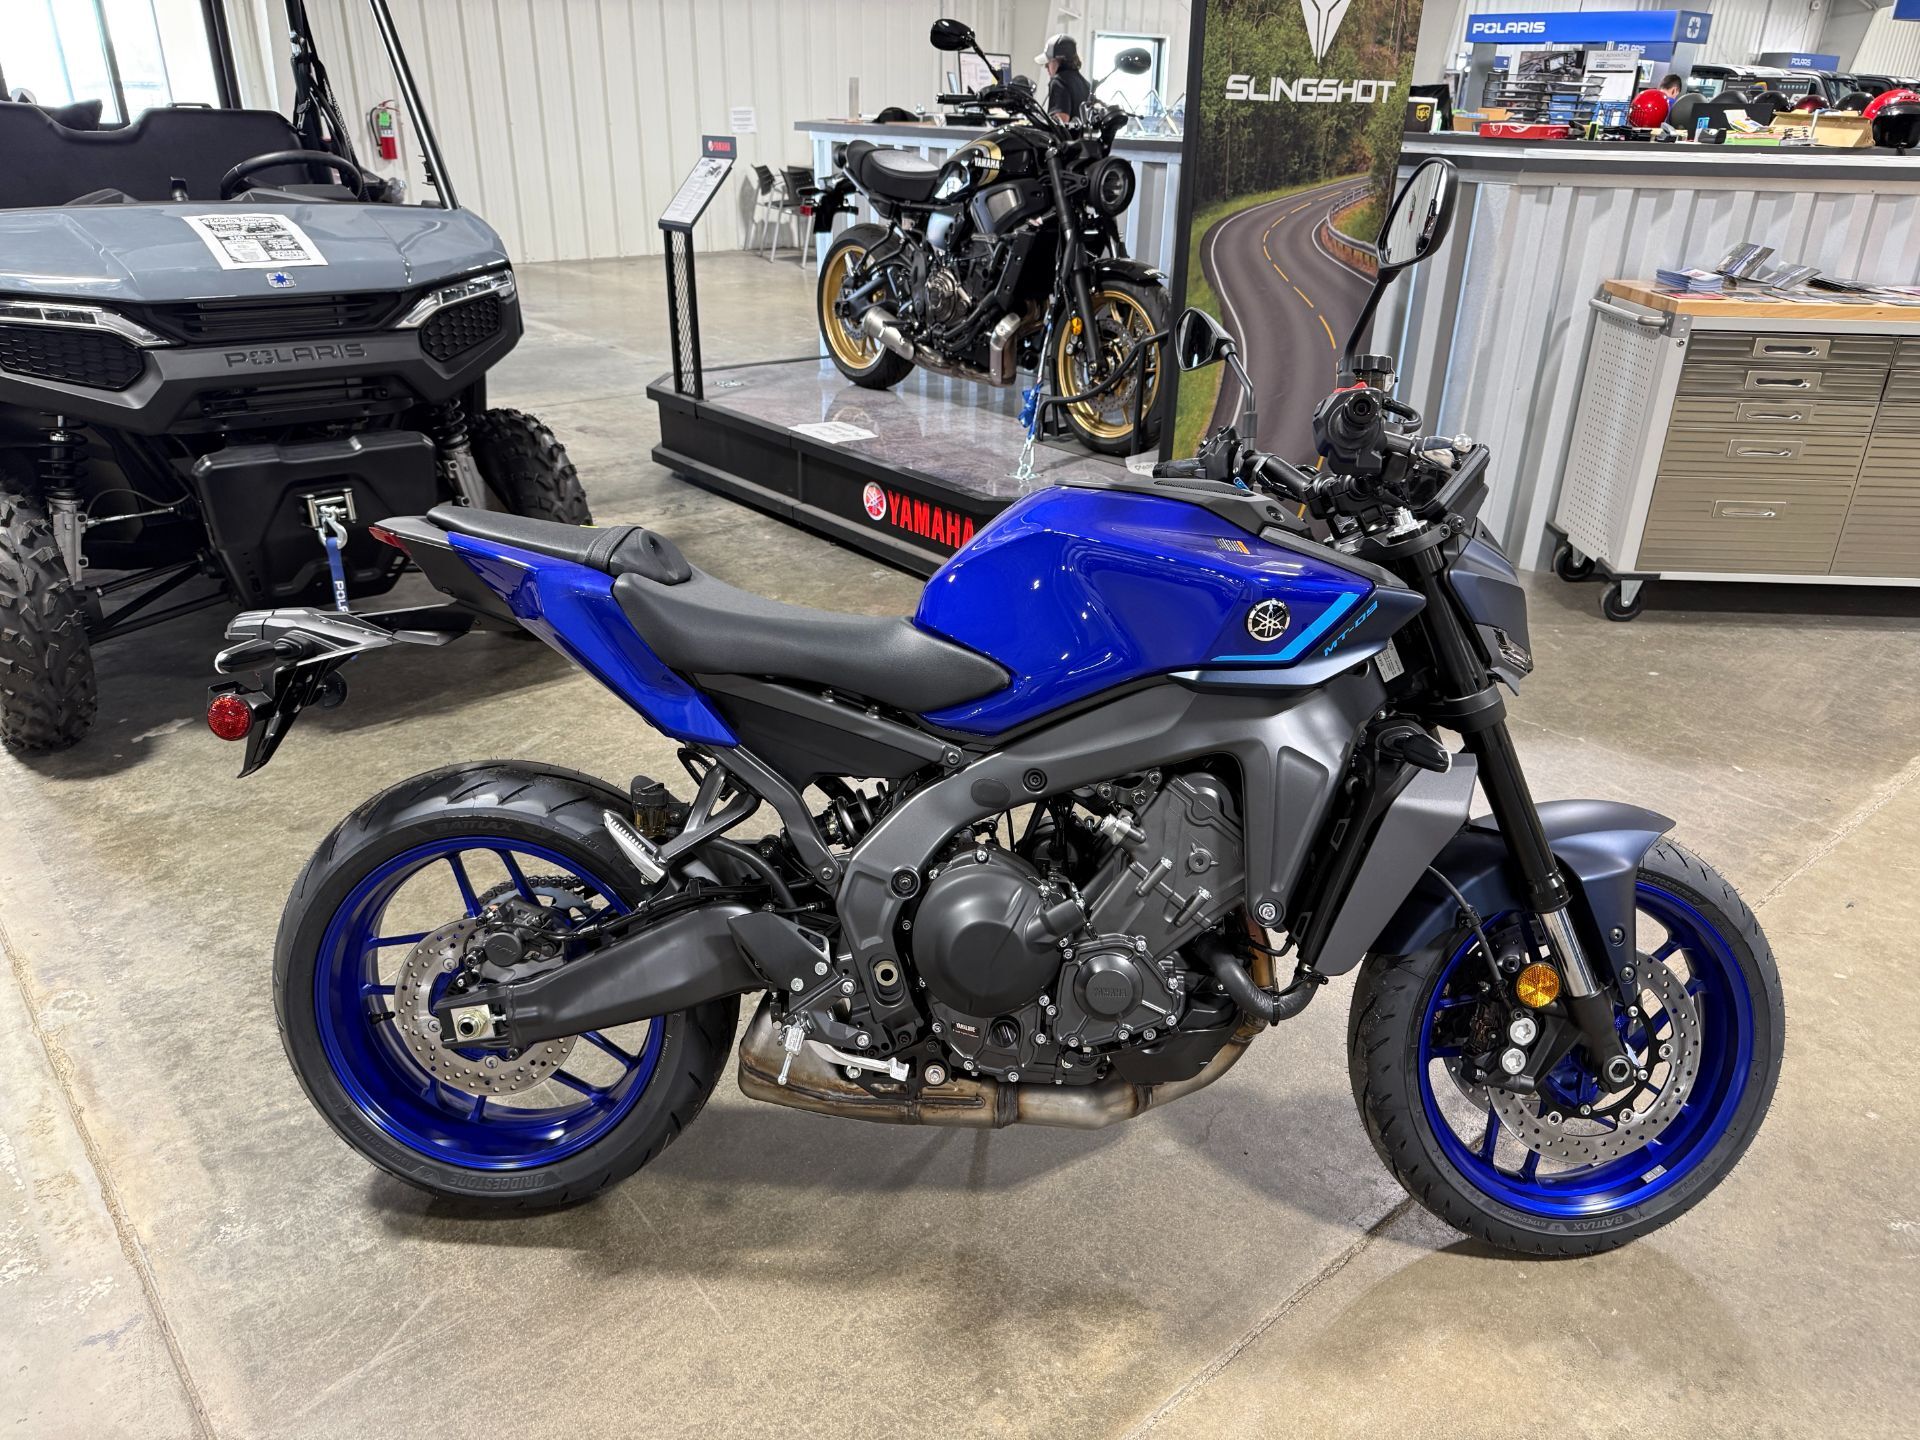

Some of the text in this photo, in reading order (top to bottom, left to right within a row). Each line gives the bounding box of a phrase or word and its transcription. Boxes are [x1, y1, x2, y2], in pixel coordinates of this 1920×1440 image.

[1472, 21, 1546, 34] POLARIS
[1791, 57, 1812, 67] POLARIS
[1225, 74, 1397, 104] SLINGSHOT
[974, 156, 1000, 170] YAMAHA
[224, 343, 367, 368] POLARIS
[888, 489, 975, 549] YAMAHA
[1324, 601, 1378, 657] MT-09
[434, 820, 513, 833] BATTLAX
[450, 1172, 546, 1190] BRIDGESTONE
[1572, 1214, 1625, 1231] BATTLAX
